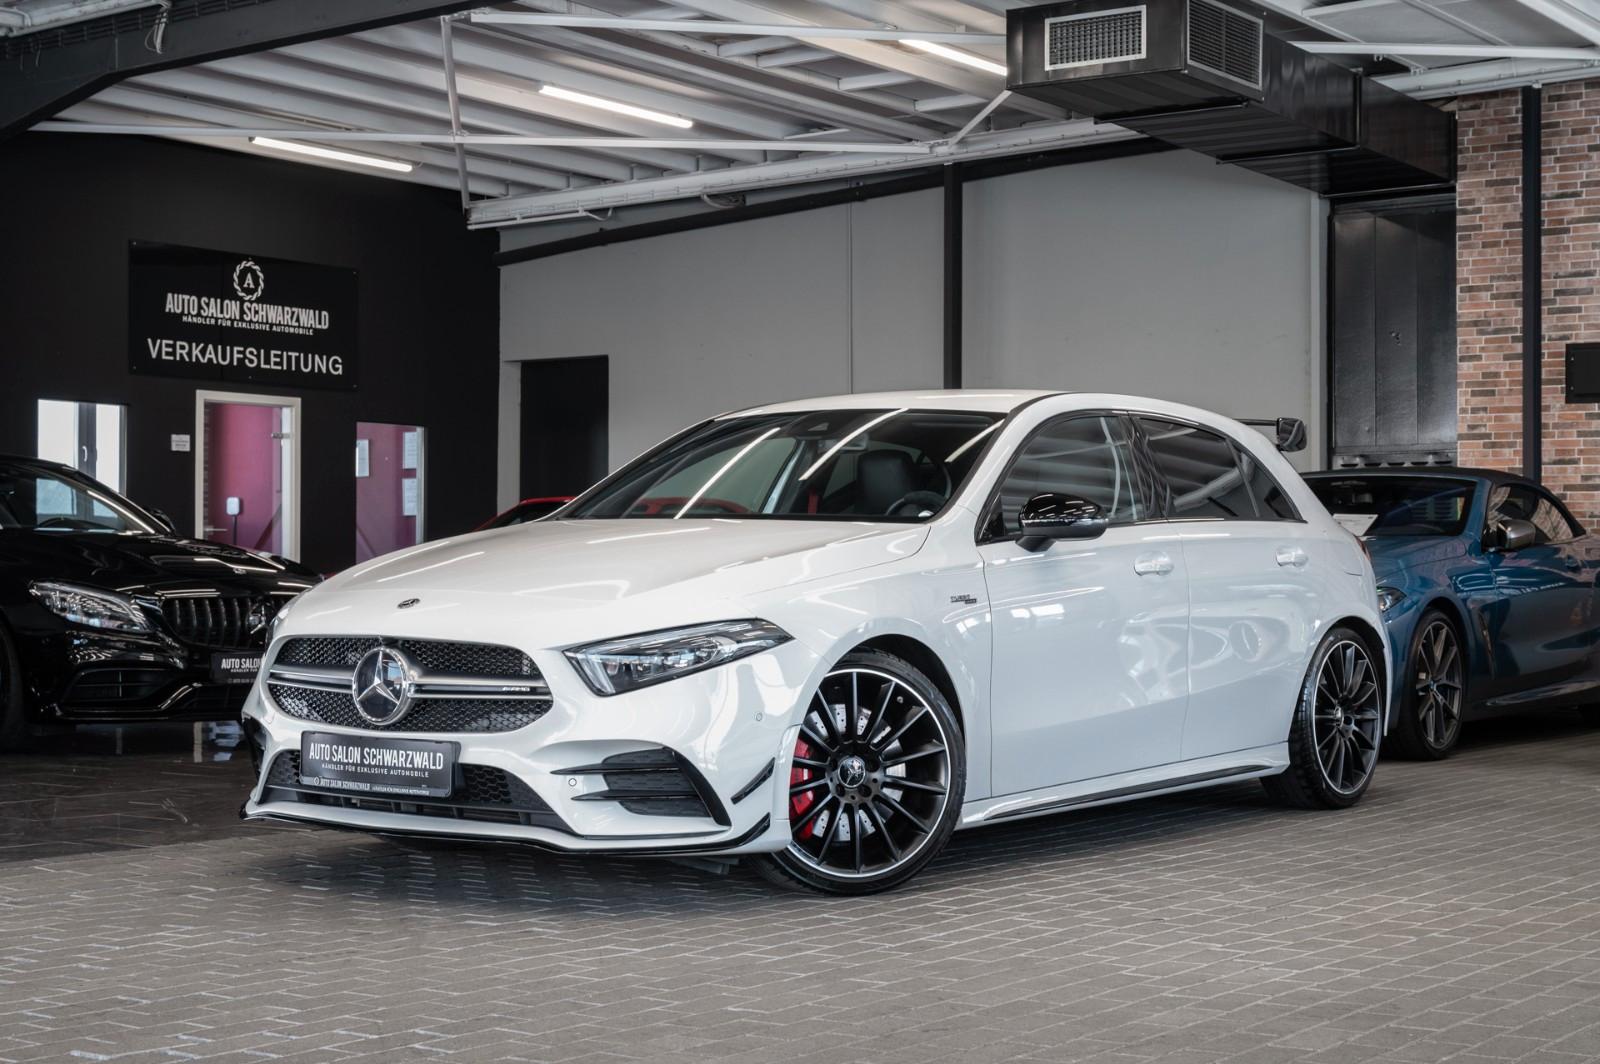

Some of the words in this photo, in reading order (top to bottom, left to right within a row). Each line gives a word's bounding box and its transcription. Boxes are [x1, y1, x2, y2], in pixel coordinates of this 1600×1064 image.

[243, 272, 255, 288] A
[165, 292, 198, 315] AUTO
[200, 296, 240, 320] SALON
[243, 302, 329, 329] SCHWARZWALD
[217, 318, 232, 327] FÜR
[233, 320, 270, 332] EXKLUSIVE
[272, 324, 314, 336] AUTOMOBILE
[147, 337, 344, 376] VERKAUFSLEITUNG
[221, 658, 240, 669] AUTO
[309, 742, 330, 760] AUTO
[332, 744, 361, 764] SALON
[363, 747, 444, 770] SCHWARZWALD
[357, 766, 388, 775] EXKLUSIVE
[389, 769, 430, 778] AUTOMOBILE
